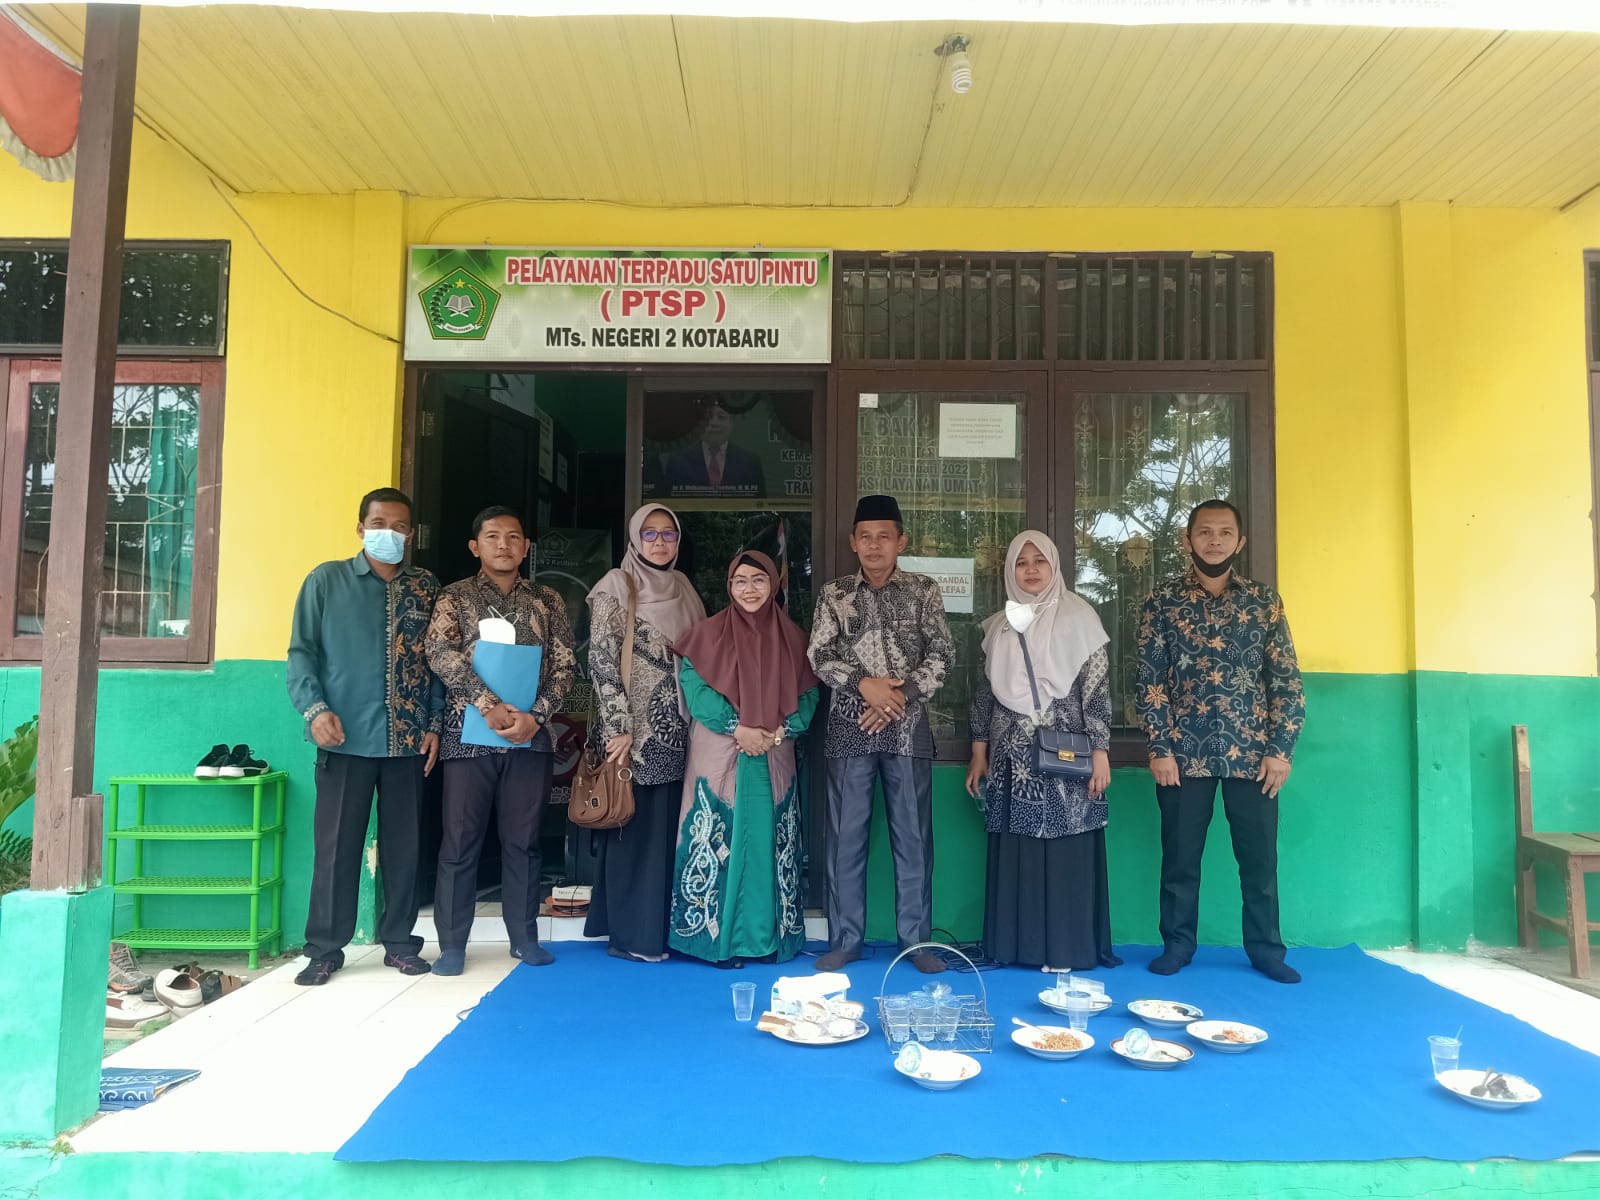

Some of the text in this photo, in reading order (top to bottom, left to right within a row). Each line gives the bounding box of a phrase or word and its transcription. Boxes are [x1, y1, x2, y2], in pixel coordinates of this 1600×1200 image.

[506, 257, 818, 285] PELAYANAN TERPADU SATU PINTU
[621, 290, 706, 317] PTSP
[545, 327, 780, 348] MTs. NEGERI 2 KOTABARU
[942, 462, 969, 475] 2022
[883, 477, 940, 493] LAYANAN
[943, 479, 980, 493] UMAT
[937, 575, 970, 585] SANDAL
[939, 585, 967, 594] LEPAS
